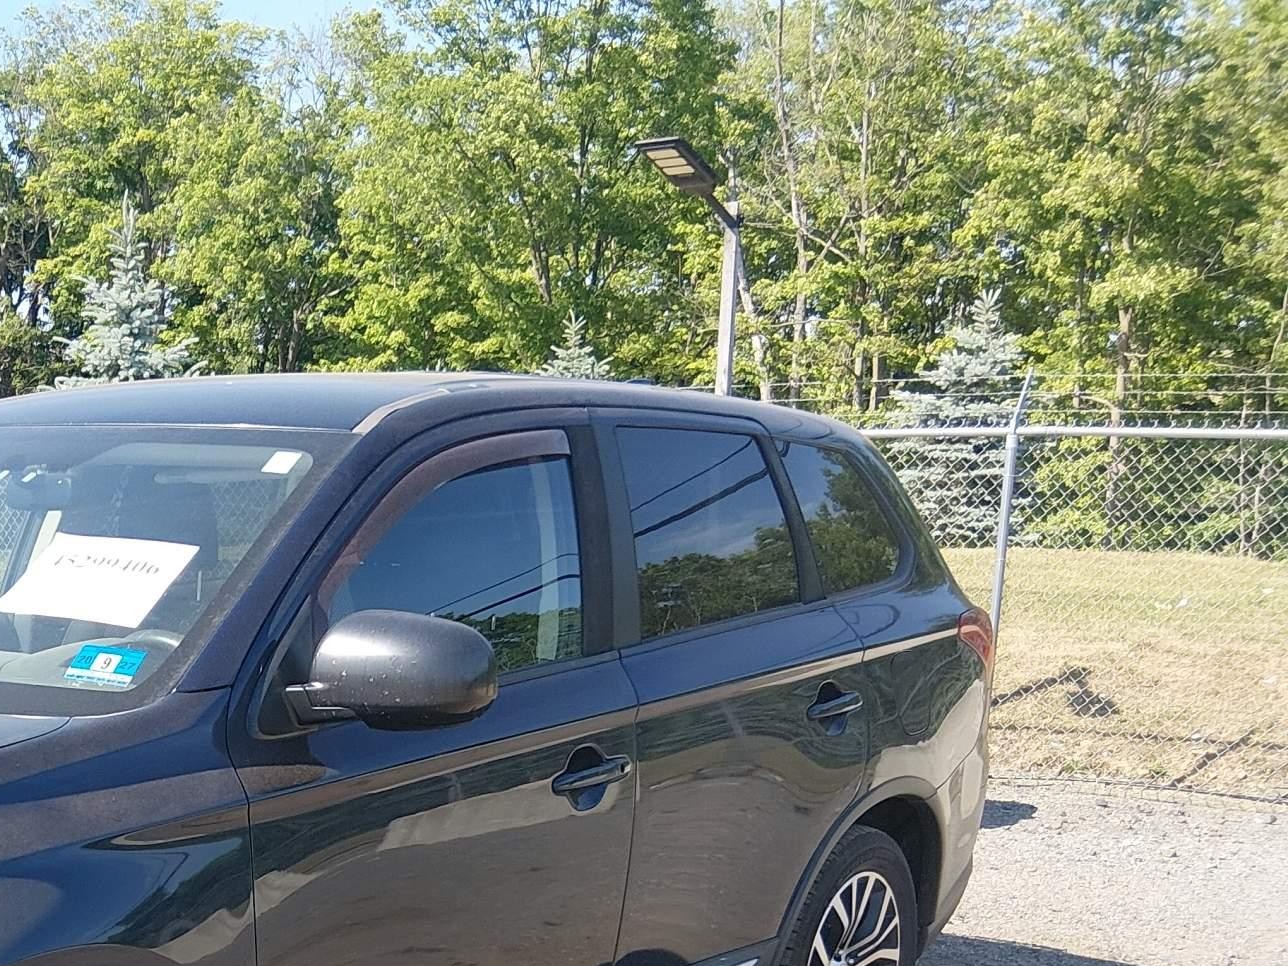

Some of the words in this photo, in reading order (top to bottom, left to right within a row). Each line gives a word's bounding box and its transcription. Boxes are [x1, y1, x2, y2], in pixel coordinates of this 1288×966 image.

[78, 655, 93, 664] 20
[100, 656, 112, 669] 9
[118, 660, 136, 671] 27
